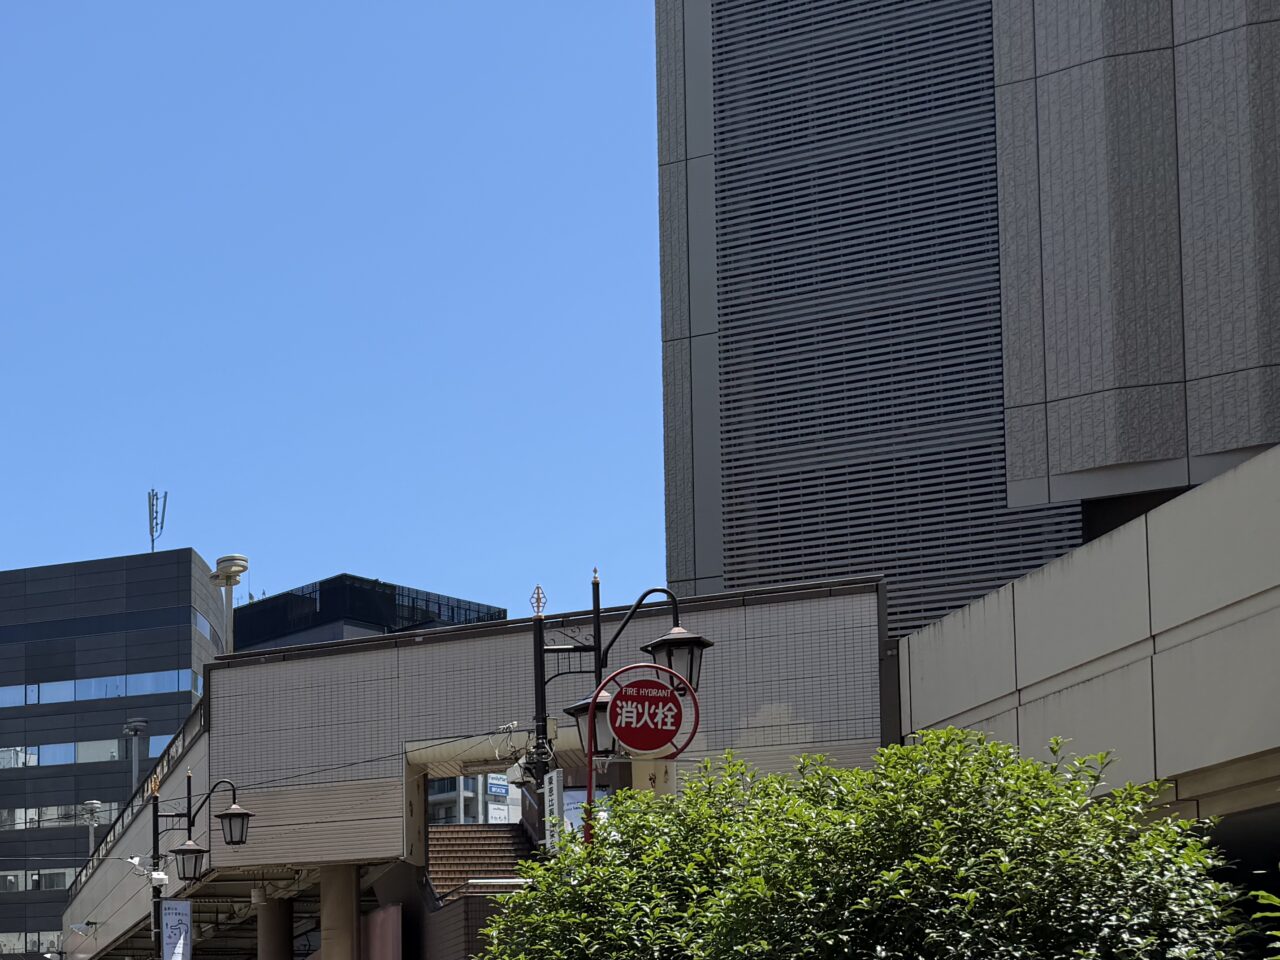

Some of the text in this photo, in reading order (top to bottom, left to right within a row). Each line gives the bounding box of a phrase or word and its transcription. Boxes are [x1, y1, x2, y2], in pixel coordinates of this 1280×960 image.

[622, 687, 672, 697] FIRE HYDRANT
[615, 700, 677, 730] 消火栓
